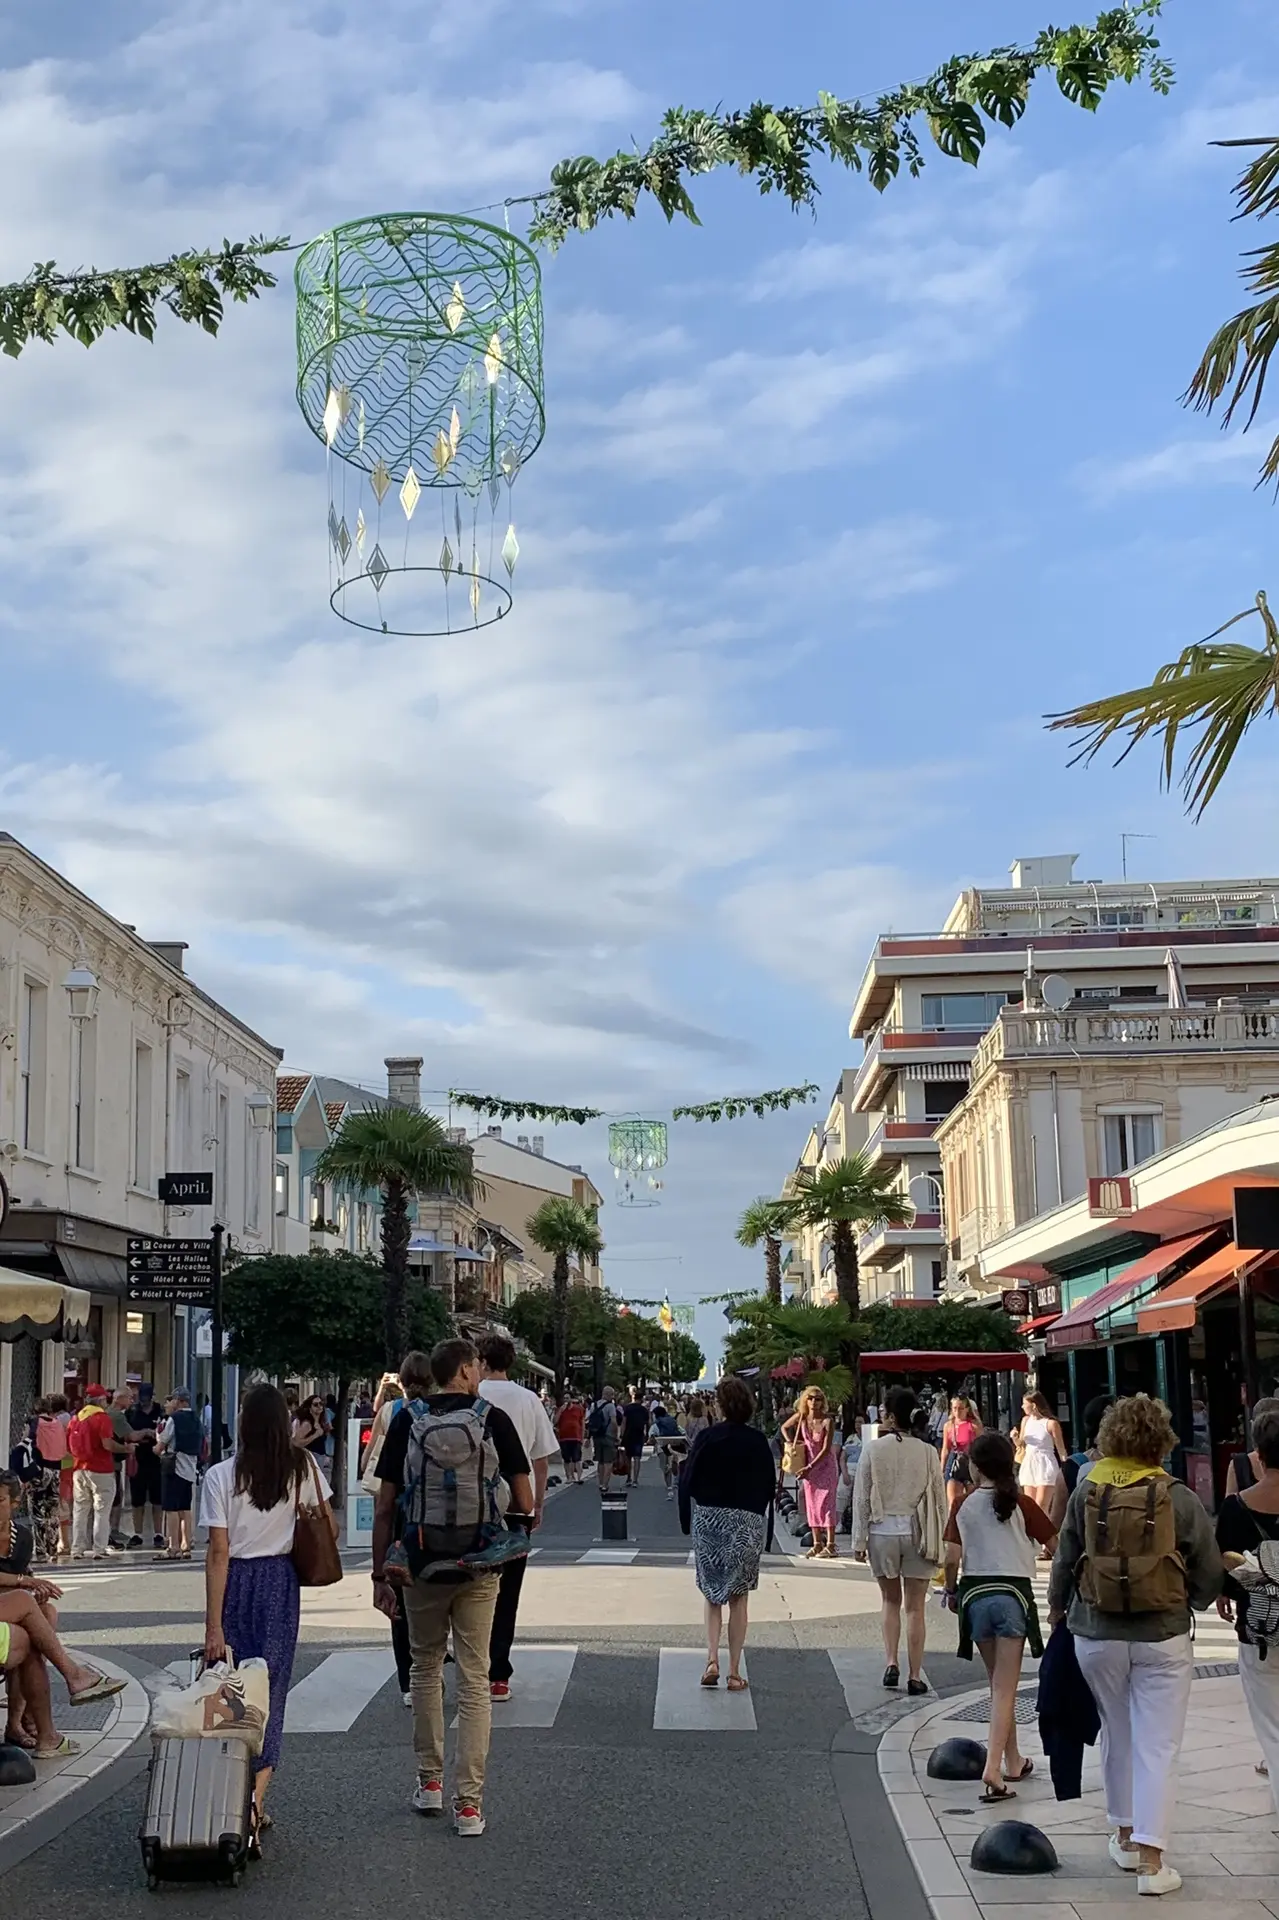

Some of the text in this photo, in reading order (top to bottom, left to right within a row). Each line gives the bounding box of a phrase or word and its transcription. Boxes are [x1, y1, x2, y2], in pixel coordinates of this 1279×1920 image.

[153, 1241, 175, 1249] Coeur
[153, 1275, 174, 1283] Hôtel
[142, 1290, 204, 1299] Hôtel La Pergola
